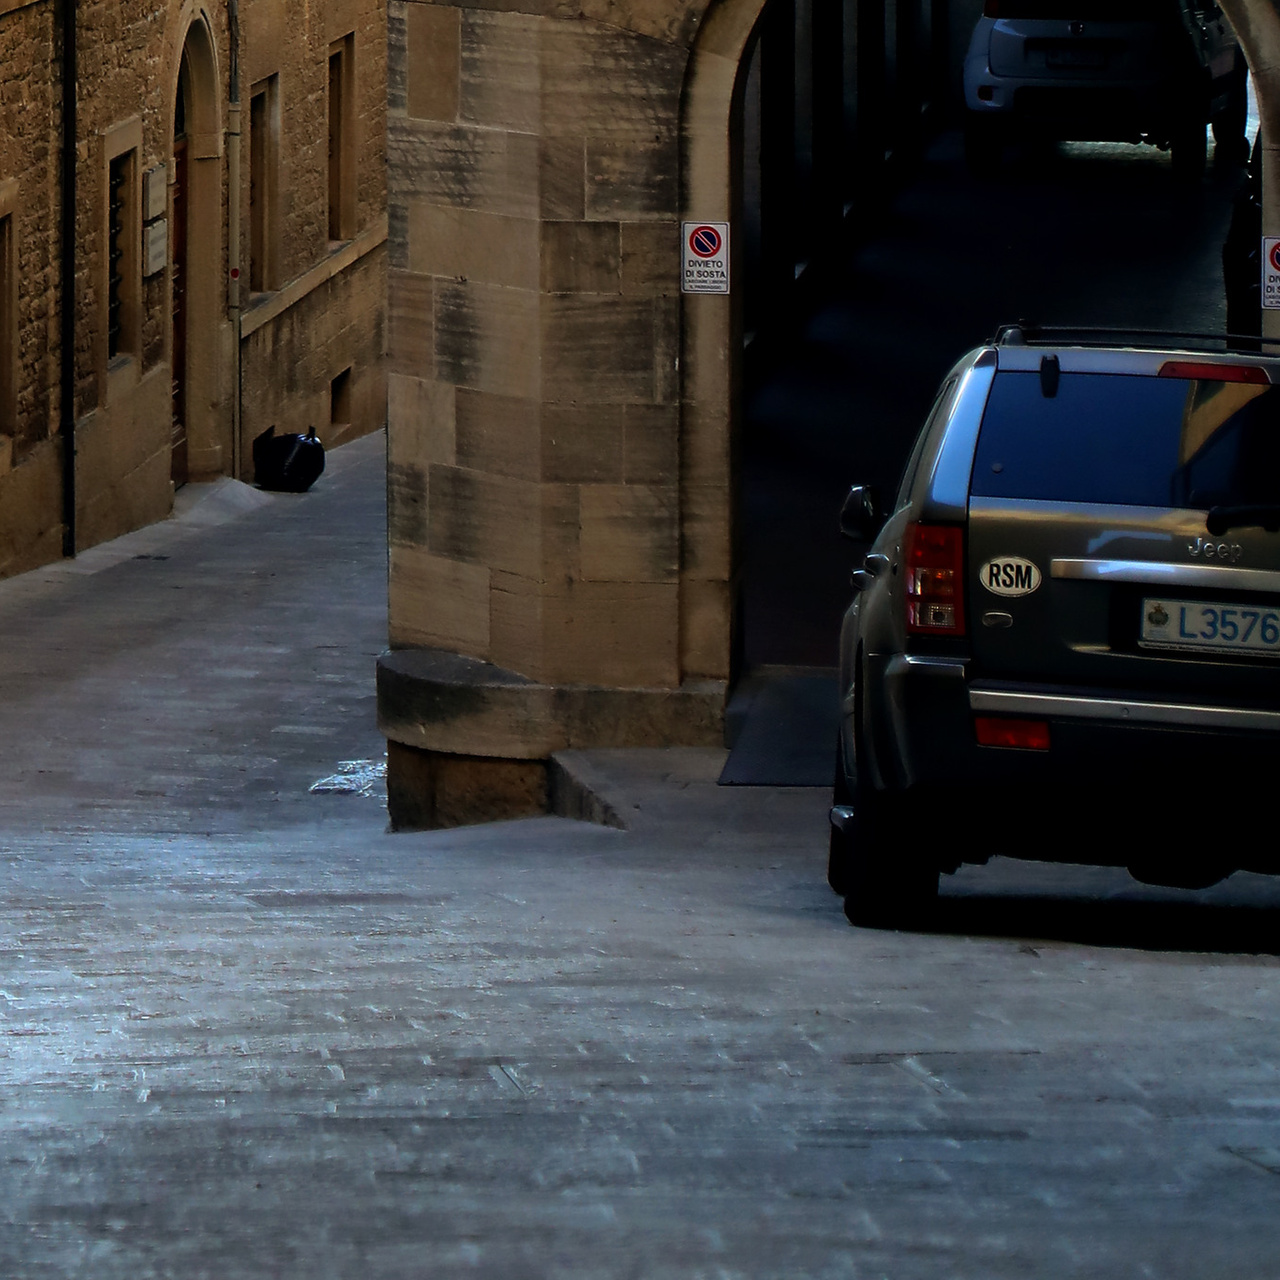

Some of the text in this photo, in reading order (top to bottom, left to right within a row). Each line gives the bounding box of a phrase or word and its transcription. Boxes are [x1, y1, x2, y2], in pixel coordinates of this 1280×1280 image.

[685, 270, 726, 278] DI SOSTA
[688, 259, 724, 268] DIVIETO
[1188, 537, 1243, 563] Jeep
[988, 563, 1032, 589] RSM
[1179, 606, 1280, 645] L3576
